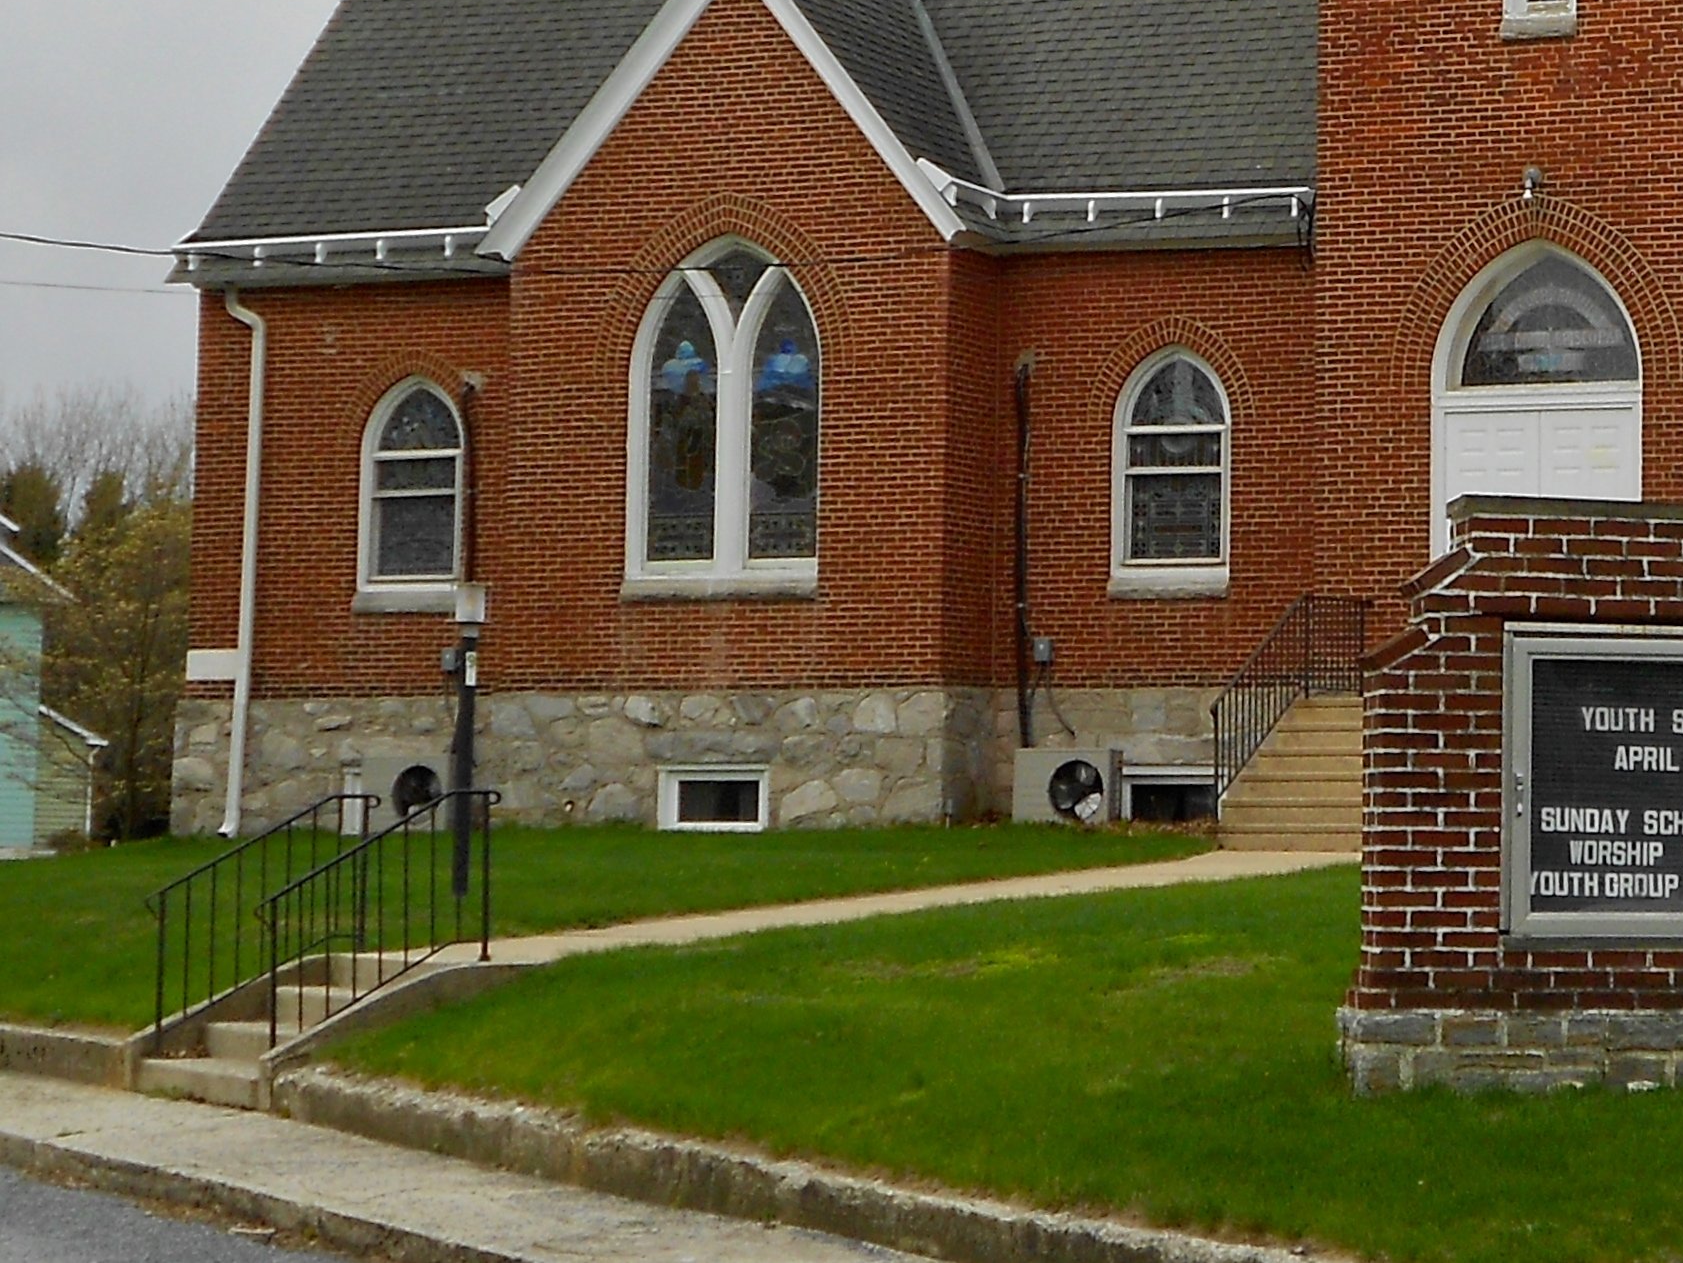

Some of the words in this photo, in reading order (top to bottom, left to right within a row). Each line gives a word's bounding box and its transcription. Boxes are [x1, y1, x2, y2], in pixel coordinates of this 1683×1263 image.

[1581, 706, 1655, 733] YOUTH
[1614, 745, 1680, 772] APRIL
[1540, 807, 1630, 834] SUNDAY
[1569, 840, 1664, 867] WORSHIP
[1604, 873, 1680, 899] GROUP
